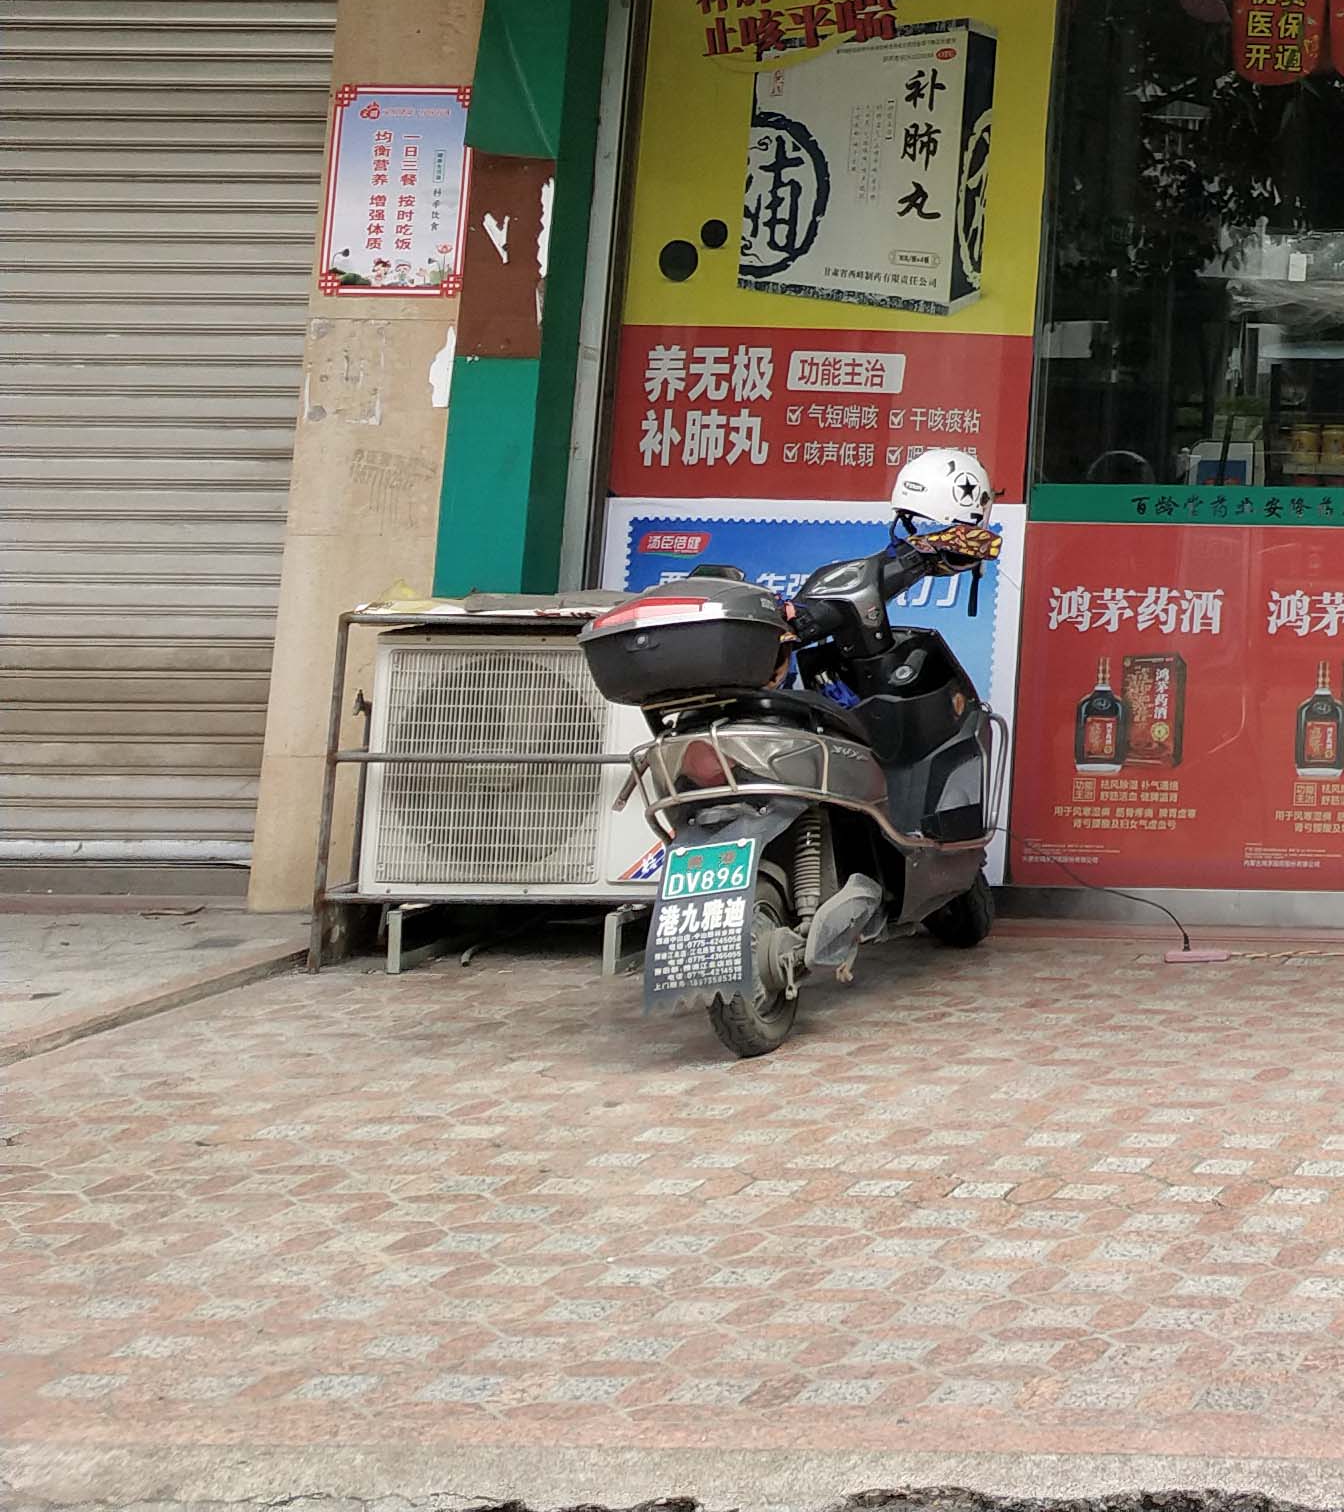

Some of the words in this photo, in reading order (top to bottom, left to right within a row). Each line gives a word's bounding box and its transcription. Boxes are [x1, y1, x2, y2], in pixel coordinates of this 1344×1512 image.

[1247, 10, 1304, 38] 医保
[1244, 43, 1302, 72] 开通
[371, 130, 394, 187] 均衡营养
[400, 133, 422, 187] 一日三餐
[896, 67, 948, 221] 补肺丸
[364, 194, 388, 251] 增强体质
[394, 194, 416, 251] 按时吃饭
[643, 344, 775, 402] 养无极
[799, 356, 886, 388] 功能主治
[638, 408, 769, 467] 补肺丸
[806, 405, 880, 430] 气短喘咳
[909, 407, 981, 434] 干咳痰粘
[803, 441, 875, 467] 咳声低弱
[1047, 586, 1225, 635] 鸿茅药酒
[668, 864, 745, 896] DV896
[656, 896, 747, 938] 港九雅迪
